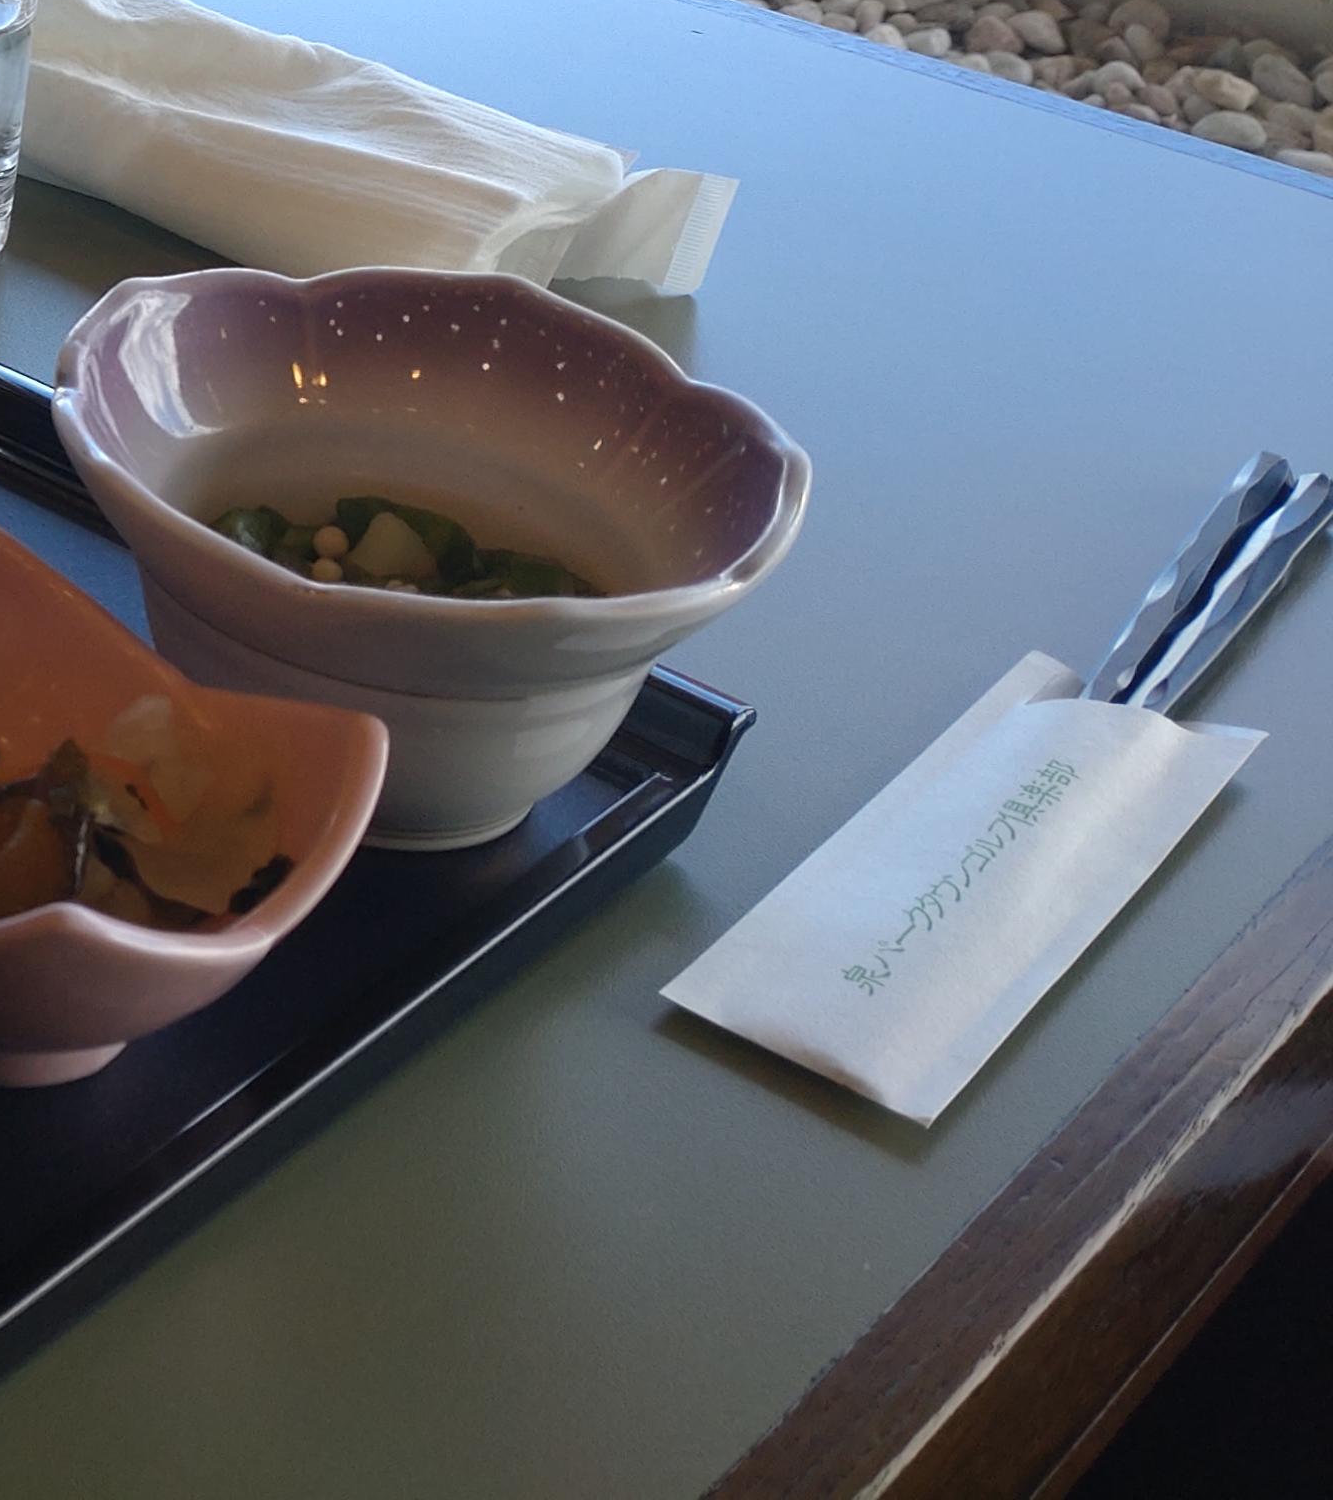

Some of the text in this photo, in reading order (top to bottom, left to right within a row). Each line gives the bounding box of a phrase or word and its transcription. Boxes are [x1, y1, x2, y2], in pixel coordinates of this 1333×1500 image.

[840, 758, 1082, 997] 泉パークタウンゴルフ倶楽部
